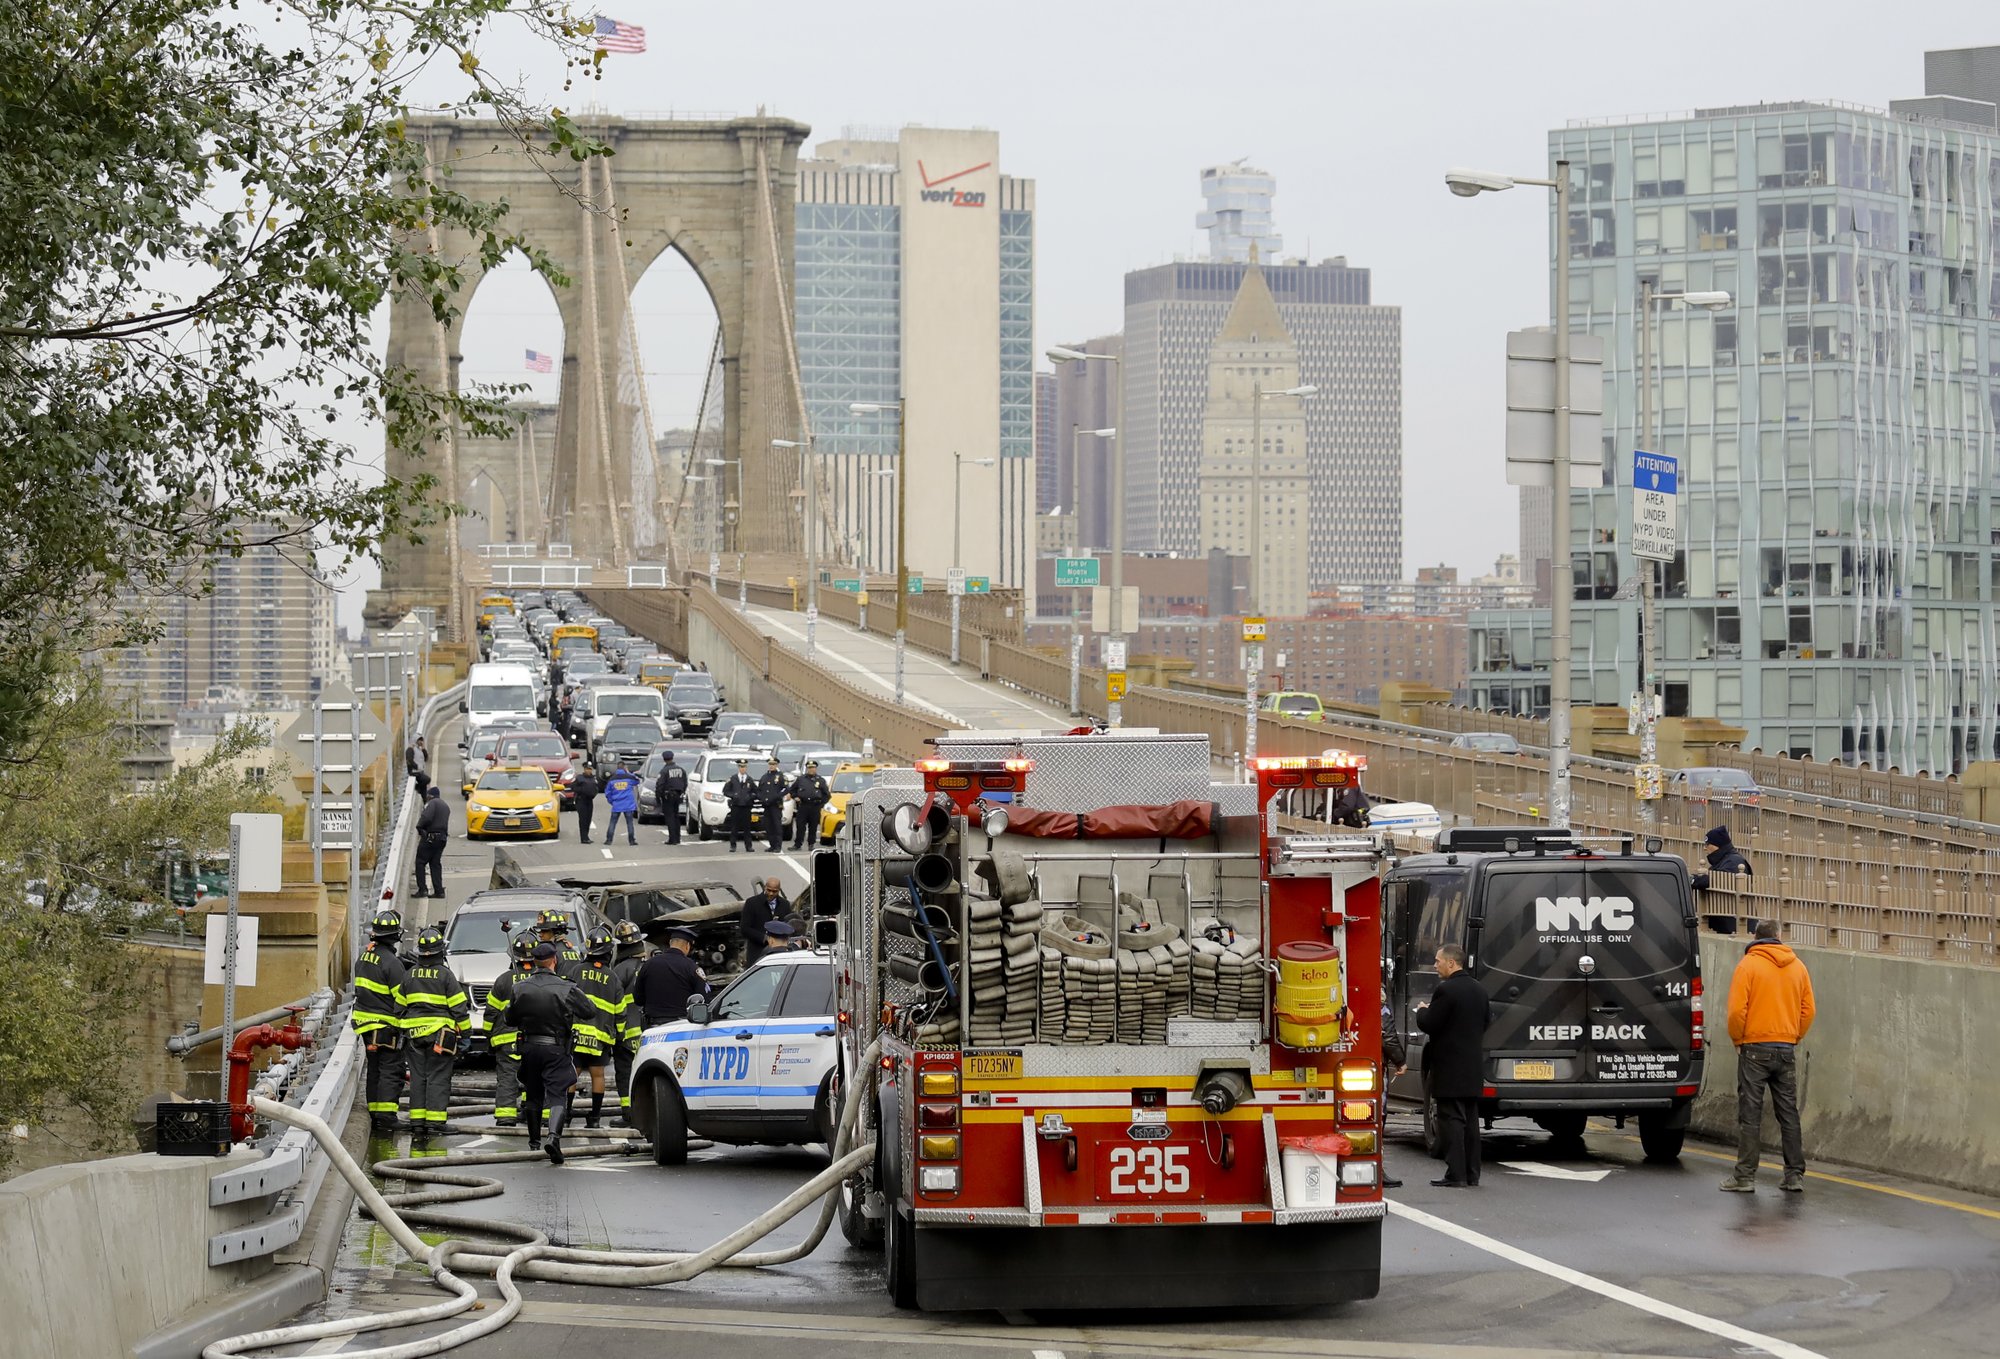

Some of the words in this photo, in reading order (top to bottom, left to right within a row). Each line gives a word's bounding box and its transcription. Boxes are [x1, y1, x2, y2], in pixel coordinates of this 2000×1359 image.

[921, 187, 986, 207] verizon
[1637, 456, 1676, 475] ATTENTION
[1645, 492, 1665, 506] AREA
[1643, 507, 1667, 523] UNDER
[1634, 522, 1654, 537] NYPD
[1656, 526, 1675, 540] VIDEO
[1633, 538, 1674, 556] SURVEILLANCE
[1535, 896, 1635, 931] NYC
[1538, 935, 1581, 943] OFFICIAL
[1584, 935, 1603, 943] USE
[1608, 934, 1632, 943] ONLY
[1301, 968, 1329, 983] igloo
[1664, 982, 1689, 997] 141
[1529, 1025, 1583, 1041] KEEP
[1591, 1024, 1646, 1040] BACK
[1325, 1042, 1354, 1054] FEET
[699, 1046, 750, 1081] NYPD
[970, 1058, 1015, 1073] FD235NY
[1657, 1054, 1679, 1063] Operated
[1600, 1071, 1616, 1079] Please
[1110, 1146, 1190, 1194] 235
